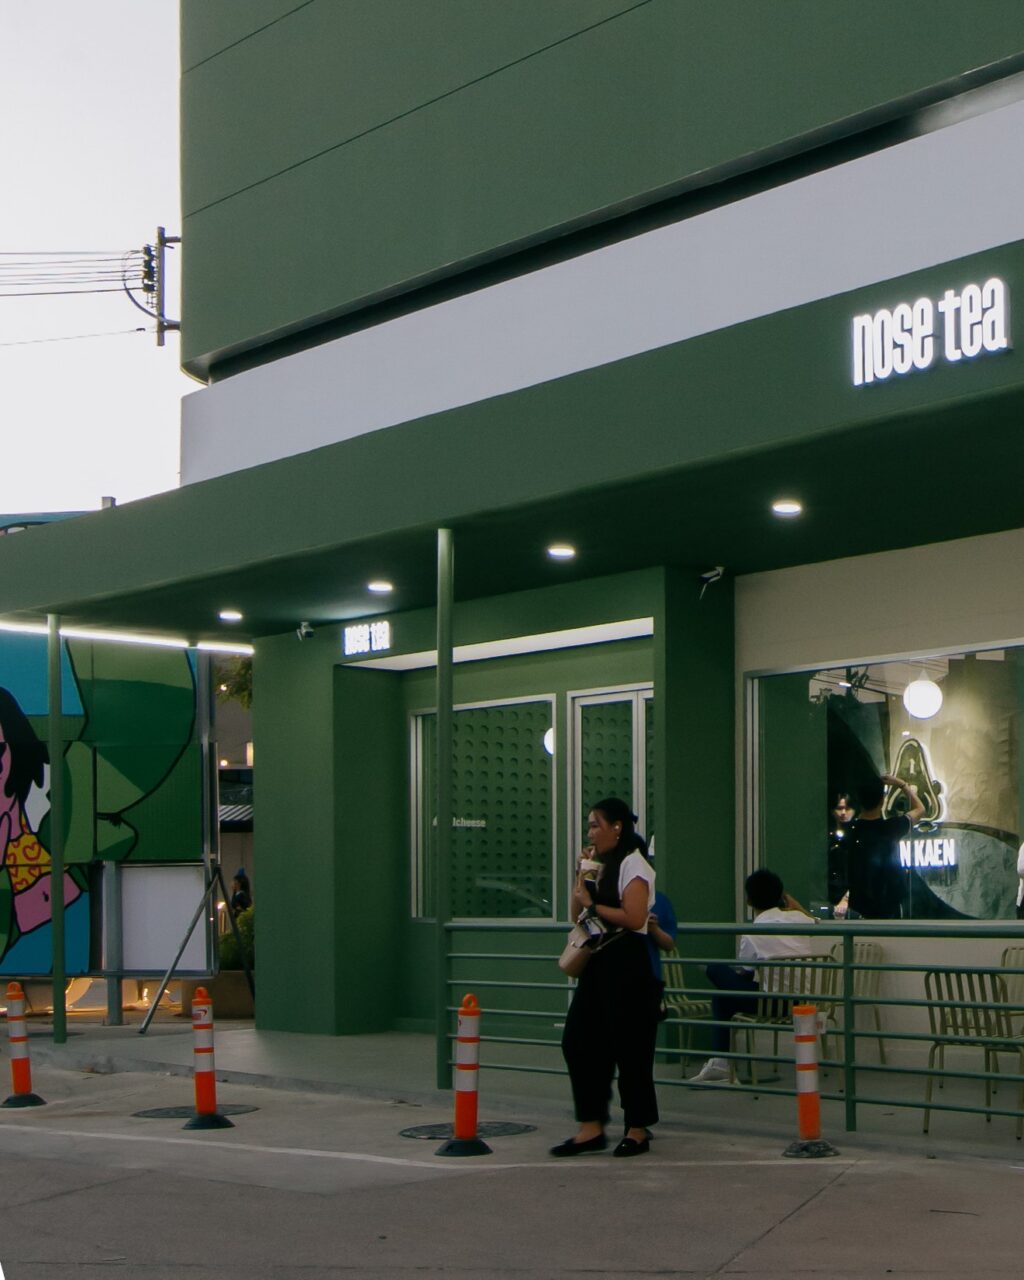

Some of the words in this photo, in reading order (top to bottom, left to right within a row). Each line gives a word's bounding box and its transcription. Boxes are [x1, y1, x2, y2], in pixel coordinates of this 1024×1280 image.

[853, 297, 934, 387] nose
[938, 277, 1009, 362] tea
[914, 838, 956, 867] KAEN
